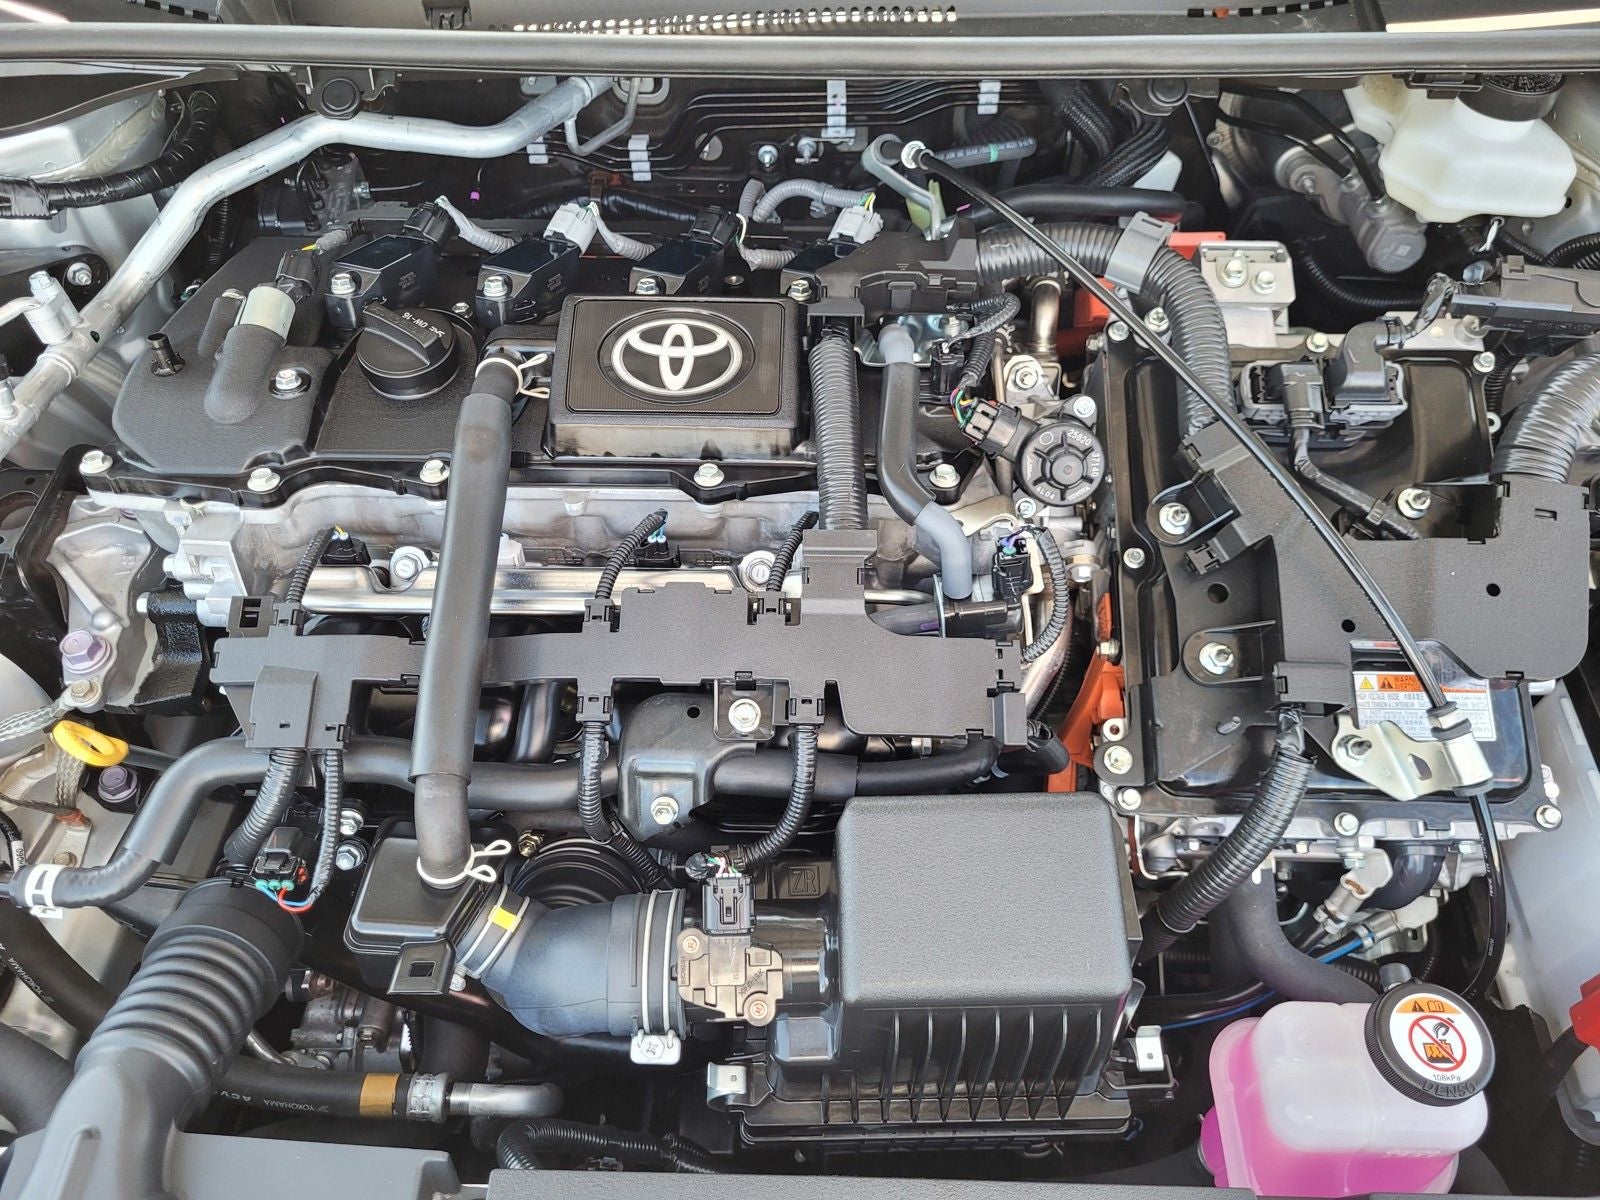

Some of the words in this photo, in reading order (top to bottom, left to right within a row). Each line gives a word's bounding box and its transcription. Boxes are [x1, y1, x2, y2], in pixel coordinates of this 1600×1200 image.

[429, 326, 445, 337] SAE
[791, 870, 816, 893] ZR
[1433, 1074, 1460, 1082] 108kPa
[1421, 1080, 1476, 1098] DENSO
[264, 1099, 315, 1111] YOKOHAMA
